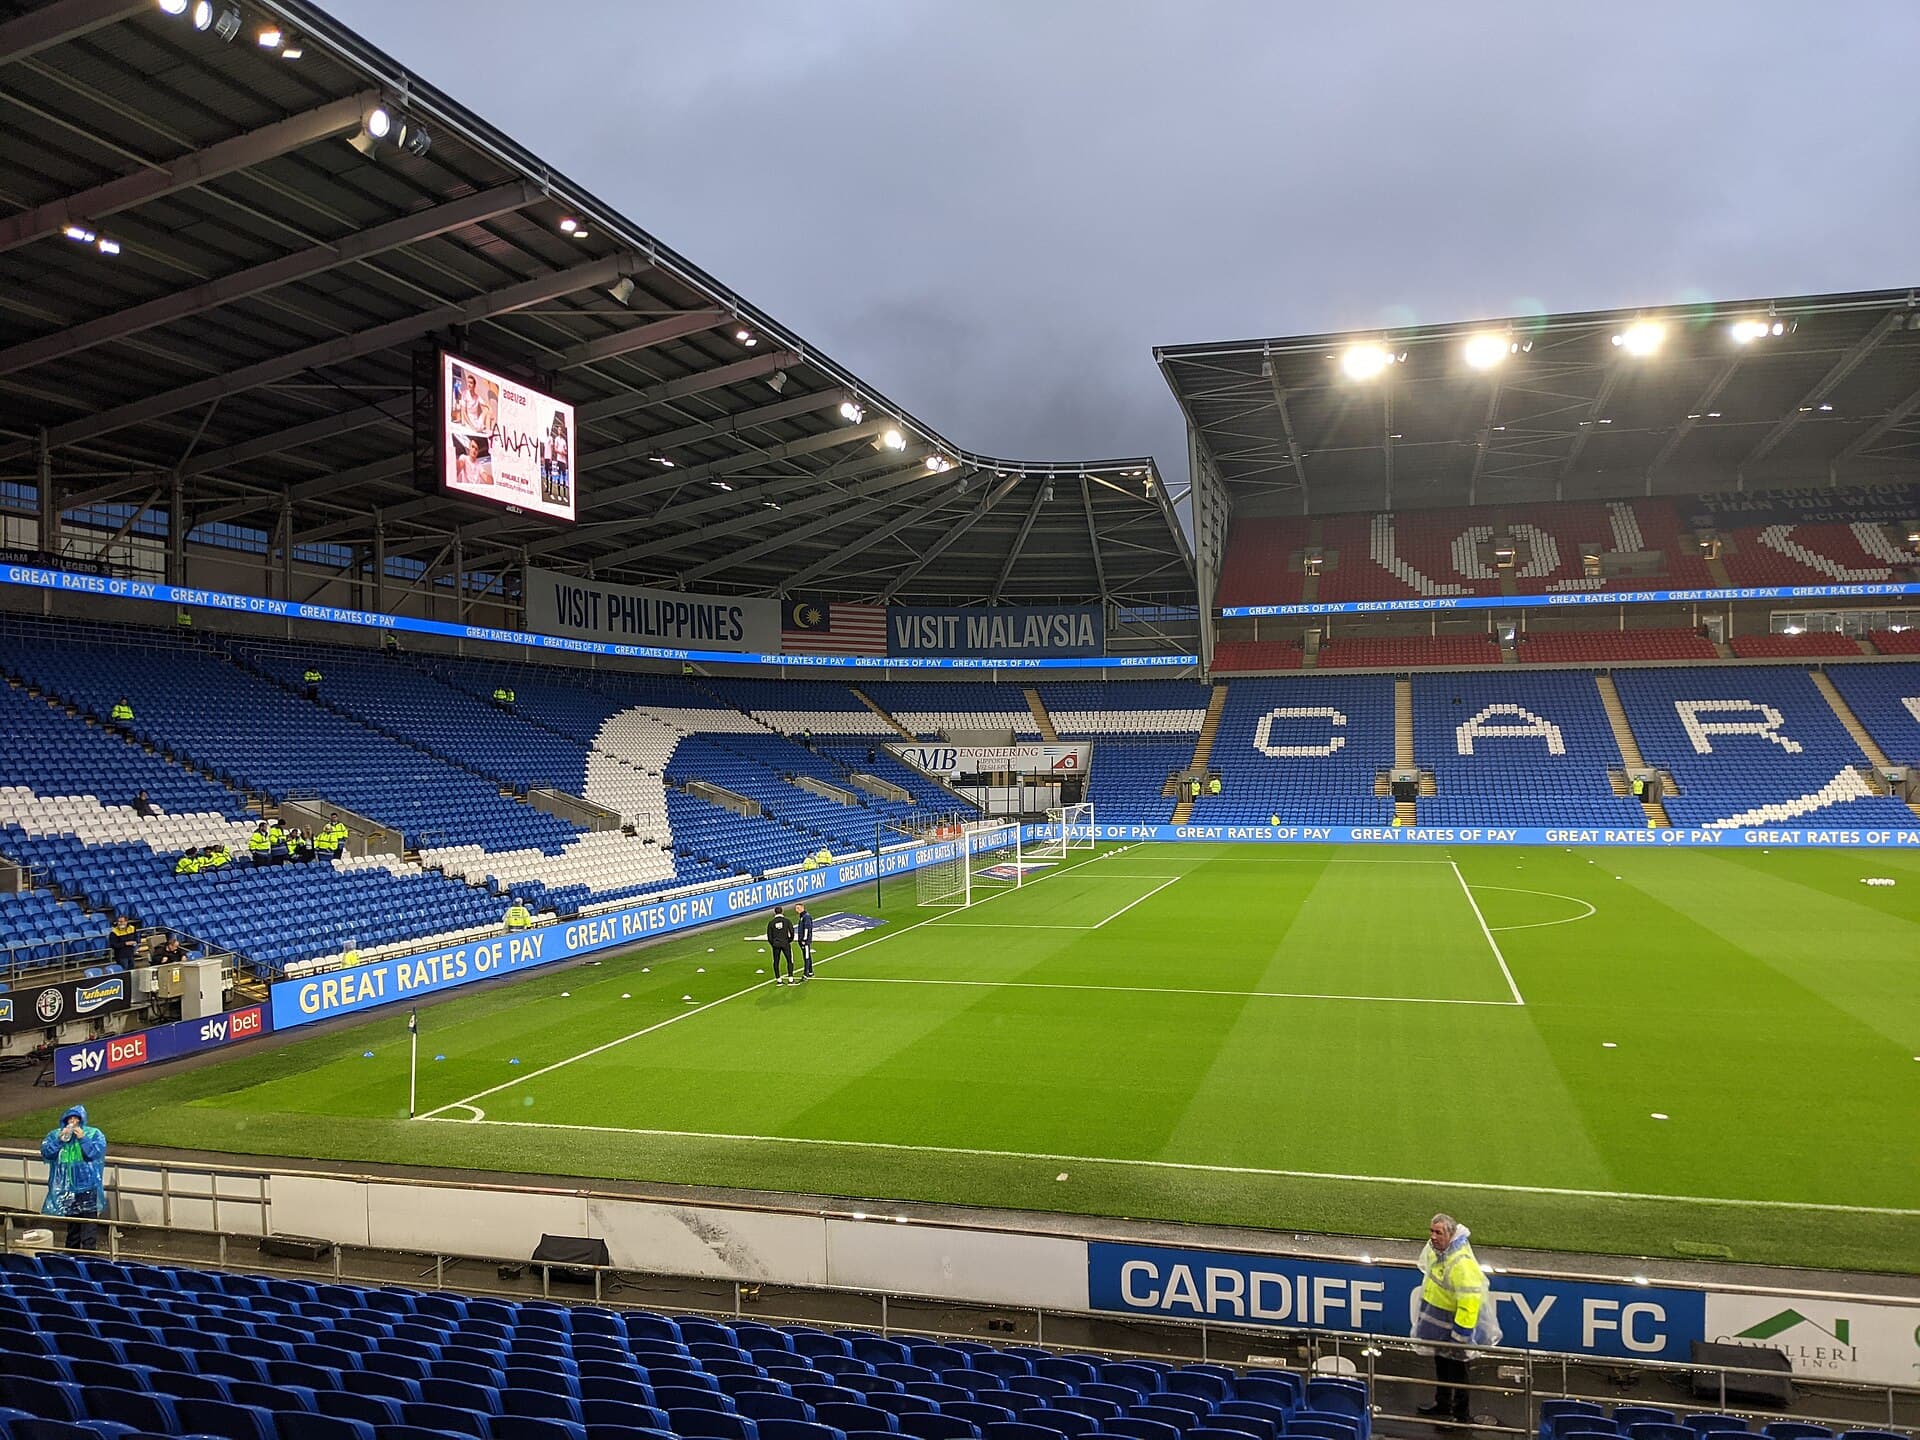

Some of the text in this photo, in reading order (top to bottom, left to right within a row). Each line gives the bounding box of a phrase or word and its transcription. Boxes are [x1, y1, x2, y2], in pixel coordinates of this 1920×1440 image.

[503, 389, 527, 406] 2021/22
[488, 424, 539, 464] AWAY
[1704, 494, 1913, 512] THAN YOU WILL
[10, 568, 154, 596] GREAT RATES OF PAY
[1793, 584, 1905, 595] GREAT RATES OF PAY
[171, 588, 287, 614] GREAT RATES OF PAY
[1549, 592, 1656, 603] GREAT RATES OF PAY
[1669, 588, 1779, 599] GREAT RATES OF PAY
[555, 583, 744, 641] VISIT PHILIPPINES
[1249, 603, 1345, 615] GREAT RATES OF PAY
[1357, 599, 1456, 610] GREAT RATES OF PAY
[300, 605, 395, 626] GREAT RATES OF PAY
[467, 627, 536, 644] GREAT RATES OF PAY
[896, 613, 1095, 649] VISIT MALAYSIA
[544, 637, 606, 653] GREAT RATES OF PAY
[615, 645, 688, 659] GREAT RATES OF PAY
[761, 654, 787, 664] GREAT
[788, 654, 815, 664] RATES
[814, 657, 827, 665] OF
[856, 658, 880, 666] GREAT
[884, 659, 909, 667] RATES
[927, 659, 941, 667] PAY
[953, 659, 979, 667] GREAT
[1151, 656, 1177, 664] RATES
[1181, 656, 1192, 664] OF
[960, 748, 1038, 758] ENGINEERING
[1106, 827, 1128, 838] OF
[1133, 827, 1157, 838] PAY
[1177, 826, 1330, 838] GREAT RATES OF PAY
[1351, 829, 1516, 840] GREAT RATES OF PAY
[1546, 830, 1721, 842] GREAT RATES OF PAY
[1745, 831, 1920, 843] GREAT RATES OF PA
[916, 849, 934, 865] GREAT
[838, 864, 862, 882] GREAT
[886, 856, 896, 871] OF
[897, 854, 910, 868] PAY
[728, 872, 826, 911] GREAT RATES OF PAY
[565, 896, 714, 950] GREAT RATES OF PAY
[300, 934, 544, 1014] GREAT RATES OF PAY
[201, 1013, 258, 1041] sky bet
[70, 1040, 144, 1072] sky bet
[1121, 1260, 1667, 1353] CARDIFF TY FC
[1714, 1336, 1857, 1362] ILLERI
